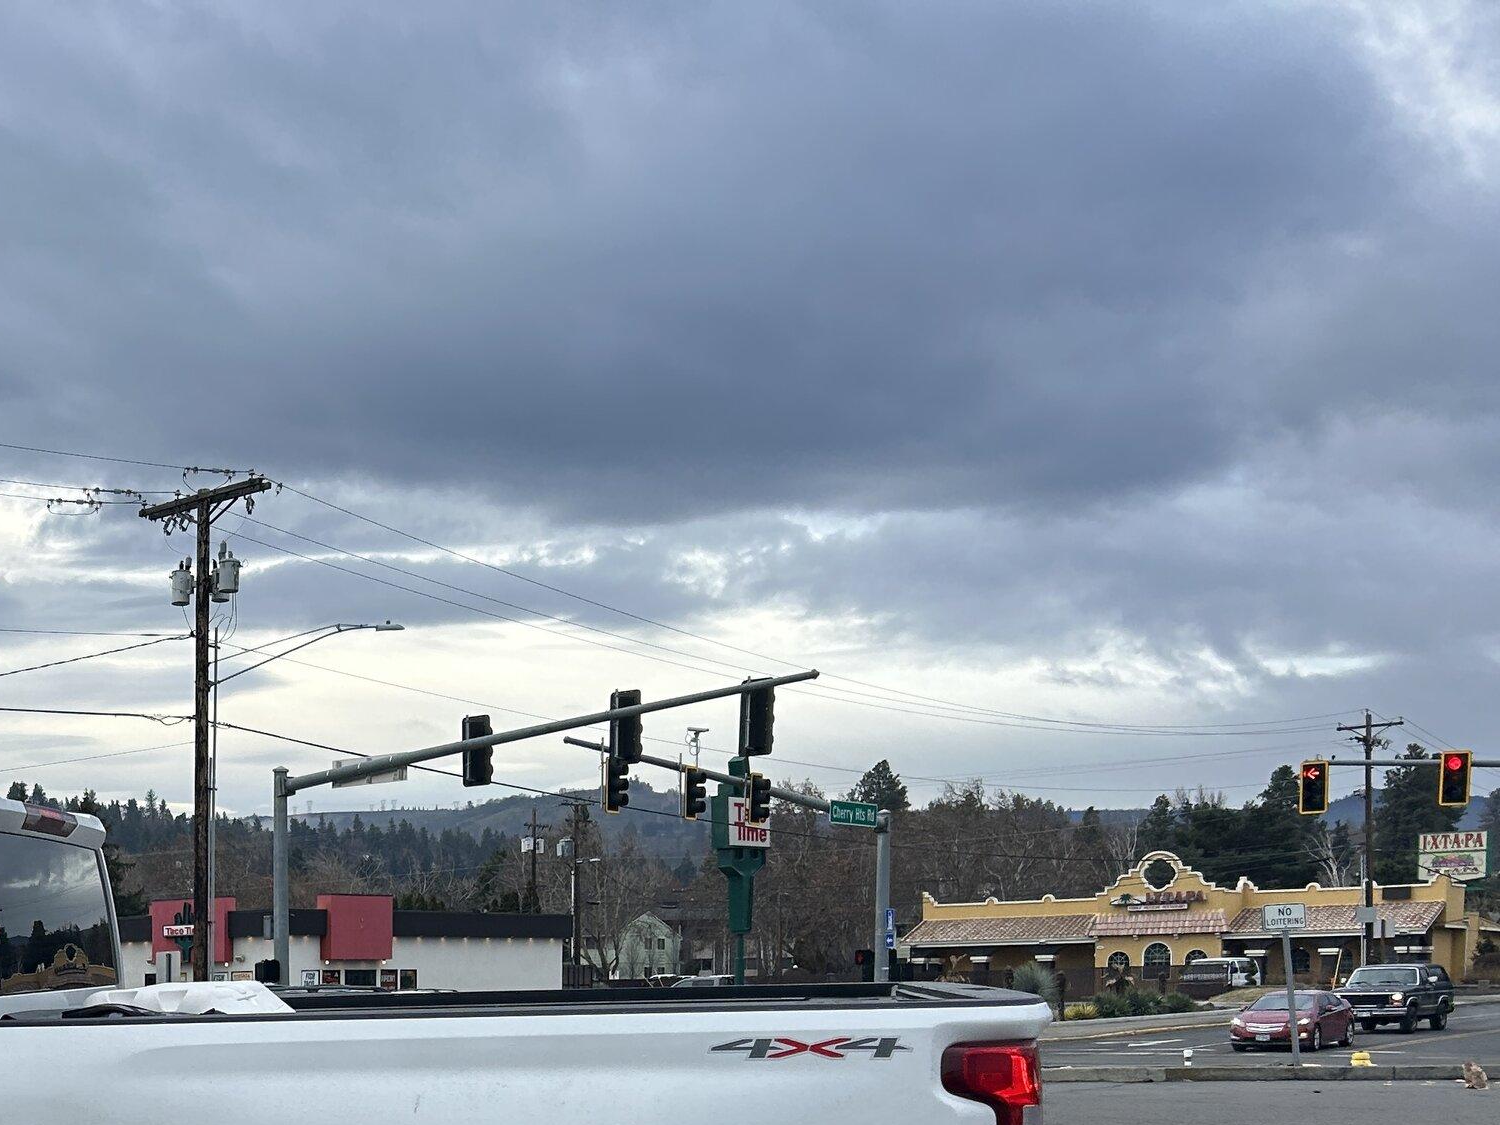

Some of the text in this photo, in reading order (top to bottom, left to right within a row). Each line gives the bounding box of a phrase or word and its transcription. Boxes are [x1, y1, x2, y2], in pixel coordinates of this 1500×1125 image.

[832, 805, 853, 823] Cherry
[867, 808, 875, 822] Rd
[734, 821, 767, 842] Time
[1422, 832, 1484, 850] IXTAPA
[1278, 907, 1292, 916] NO
[1267, 917, 1304, 926] LOITERING
